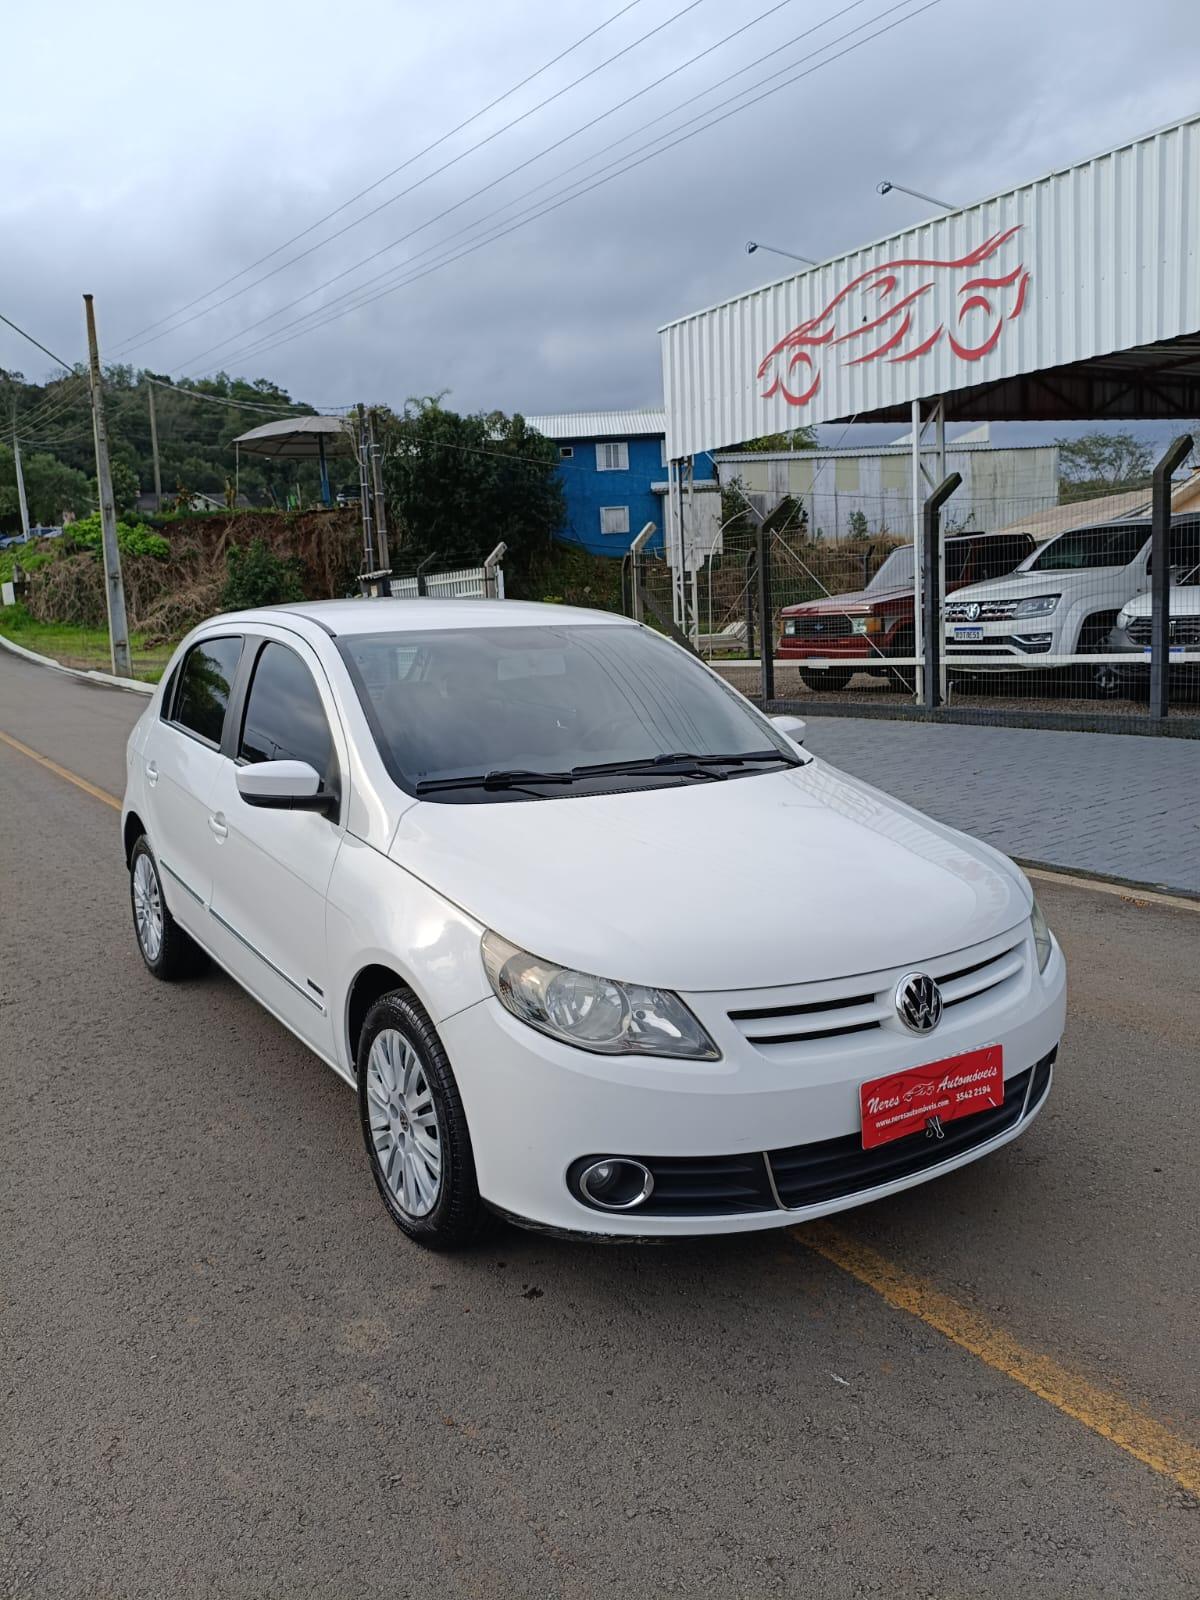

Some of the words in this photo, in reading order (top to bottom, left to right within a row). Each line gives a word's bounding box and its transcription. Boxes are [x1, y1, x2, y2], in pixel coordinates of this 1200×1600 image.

[867, 1095, 900, 1115] Neres
[936, 1066, 998, 1093] Automóveis
[955, 1089, 973, 1103] 3542
